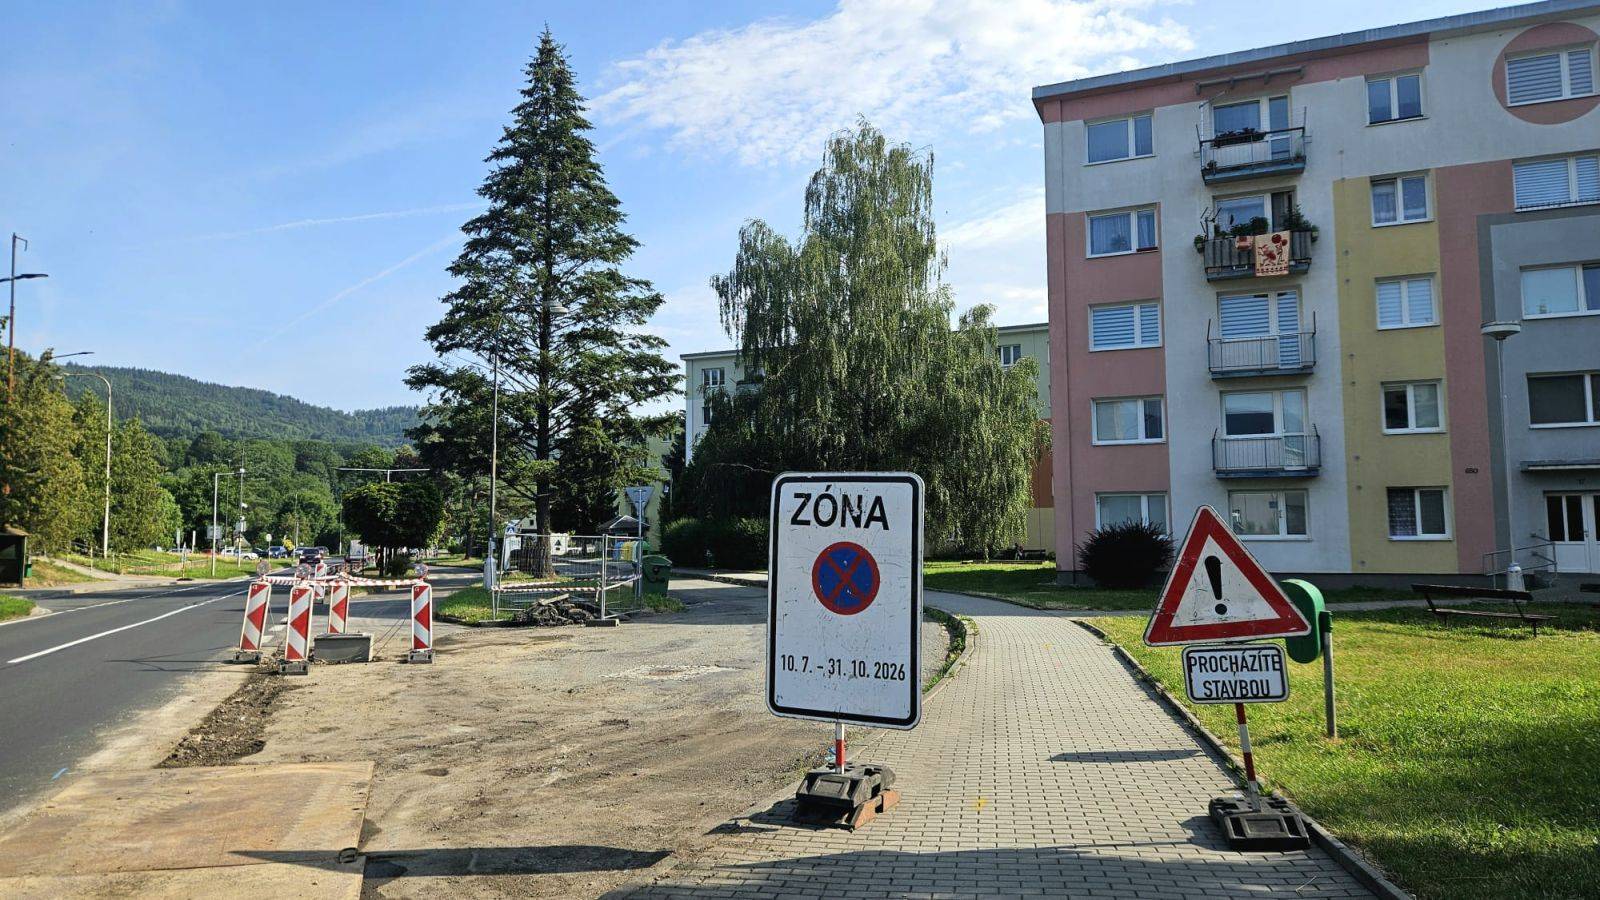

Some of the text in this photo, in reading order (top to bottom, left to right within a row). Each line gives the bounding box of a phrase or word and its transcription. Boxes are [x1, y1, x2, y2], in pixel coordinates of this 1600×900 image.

[791, 484, 889, 530] ZÓNA
[1188, 650, 1281, 673] PROCHÁZÍTE
[1203, 679, 1270, 698] STAVBOU
